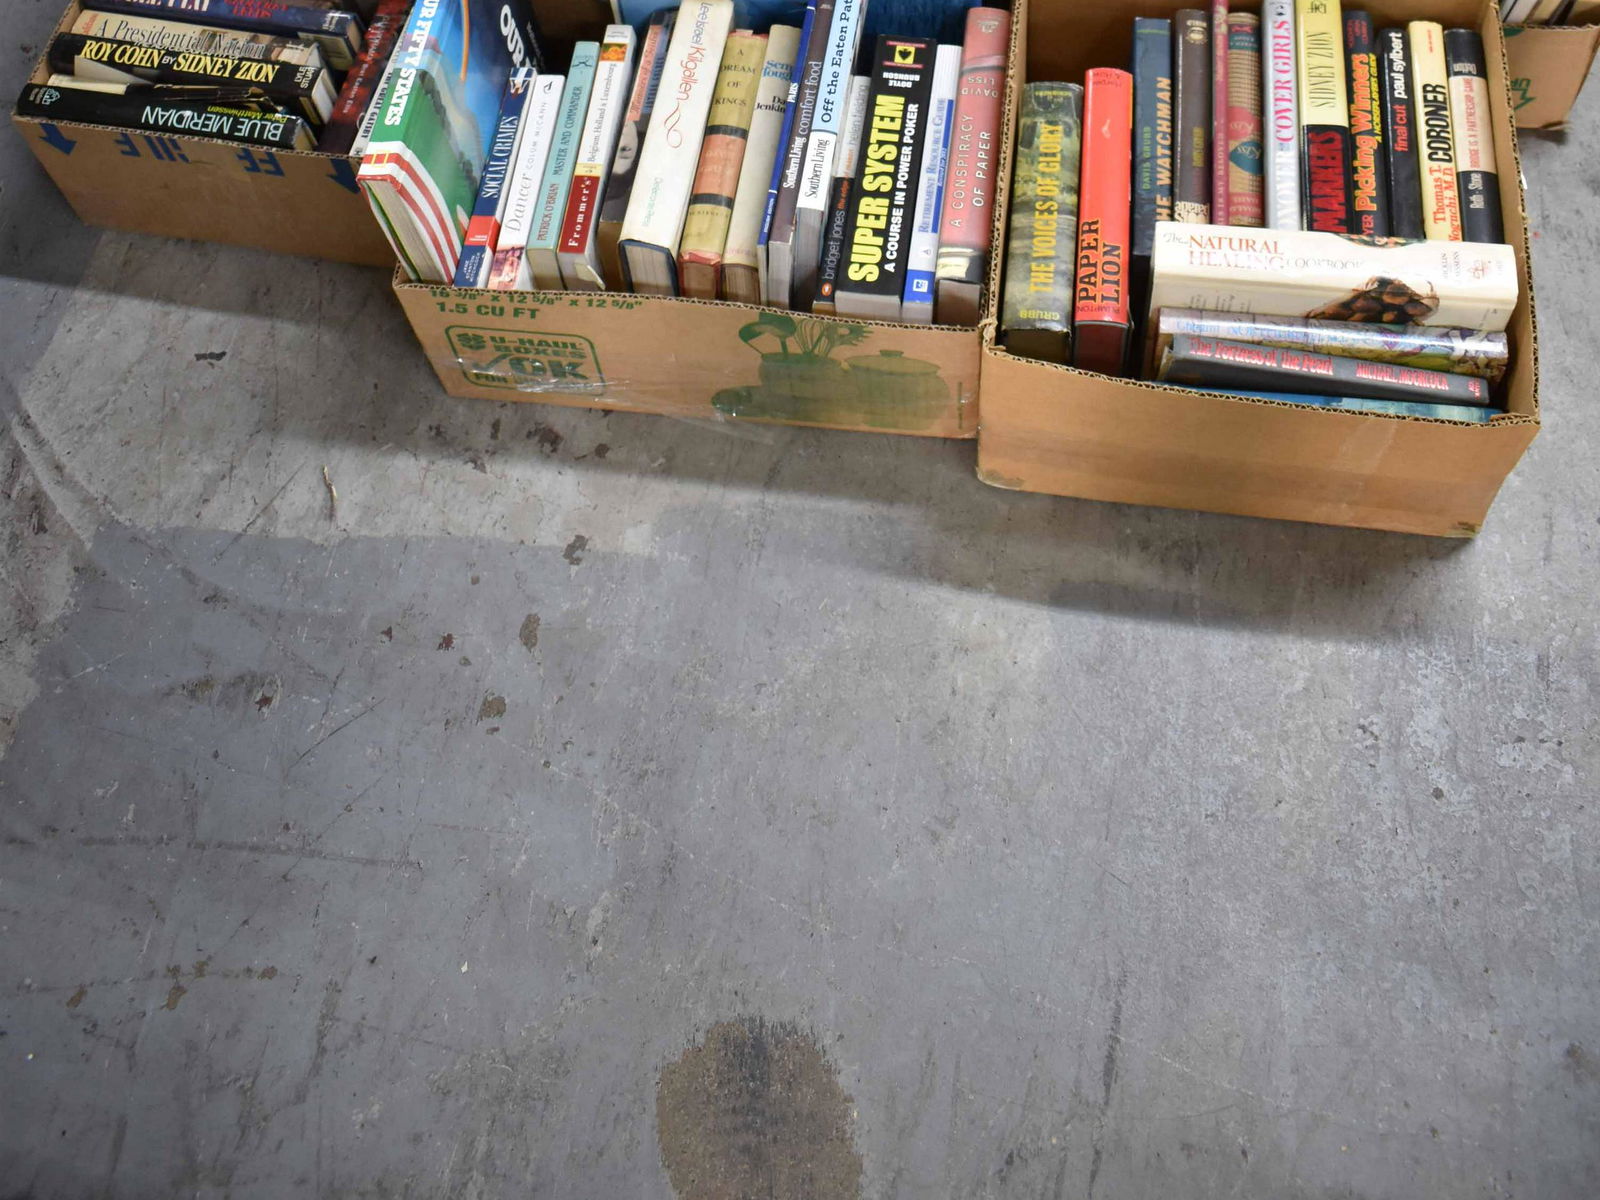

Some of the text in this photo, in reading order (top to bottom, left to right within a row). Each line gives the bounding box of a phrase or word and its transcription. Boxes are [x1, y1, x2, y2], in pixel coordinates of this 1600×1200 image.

[690, 21, 706, 48] Israel
[699, 1, 713, 22] Lee
[94, 21, 106, 37] A
[106, 19, 208, 52] Presidential
[405, 20, 433, 67] FIFTY
[500, 4, 525, 67] OUR
[831, 30, 848, 67] Eaten
[1272, 19, 1293, 76] GIRLS
[81, 40, 281, 83] ROY COHN BY SIDNEY ZION
[719, 63, 757, 75] DREAM
[726, 80, 742, 89] OF
[805, 61, 823, 87] food
[826, 71, 840, 95] the
[967, 76, 995, 85] LISS
[1306, 31, 1337, 109] SIDNEY ZION
[385, 68, 417, 126] STATES
[712, 97, 747, 107] KINGS
[787, 82, 799, 103] PARIS
[798, 87, 816, 135] comfort
[821, 97, 831, 123] Off
[961, 88, 999, 98] DAVID
[1273, 78, 1294, 143] COVER
[1388, 32, 1409, 153] final cut paul sylbert
[141, 105, 285, 142] BLUE MERIDIAN
[259, 111, 288, 125] Peter
[552, 86, 584, 177] MASTER AND COMMANDER
[1156, 77, 1172, 187] WATCHMAN
[1351, 53, 1378, 212] Picking Winners
[482, 115, 519, 199] SOCIAL CRIMES
[784, 154, 798, 189] Southern
[805, 139, 831, 199] Southern Living
[950, 114, 974, 228] A CONSPIRACY
[972, 131, 992, 207] OF PAPER
[1142, 126, 1152, 191] DAVIS GRUBB
[1422, 83, 1453, 225] Thomas T. CORONER
[504, 173, 533, 238] Dancer
[847, 94, 906, 283] SUPER SYSTEM
[884, 103, 919, 273] A COURSE IN POWER POKER
[1029, 123, 1064, 293] THE VOICES OF GLORY
[537, 211, 552, 242] PATRICK
[568, 177, 592, 247] Frommer's
[821, 209, 846, 280] bridget jones
[1078, 218, 1100, 304] PAPER
[1188, 234, 1285, 256] NATURAL
[1100, 242, 1122, 305] LION
[436, 302, 541, 320] 1.5 CU FT
[507, 293, 528, 304] 12
[586, 298, 606, 309] 12
[508, 356, 589, 380] OK
[1189, 338, 1334, 376] The Fortress of the Pearl
[1355, 362, 1400, 383] MICHAEL
[1398, 367, 1450, 391] MOORCOCK
